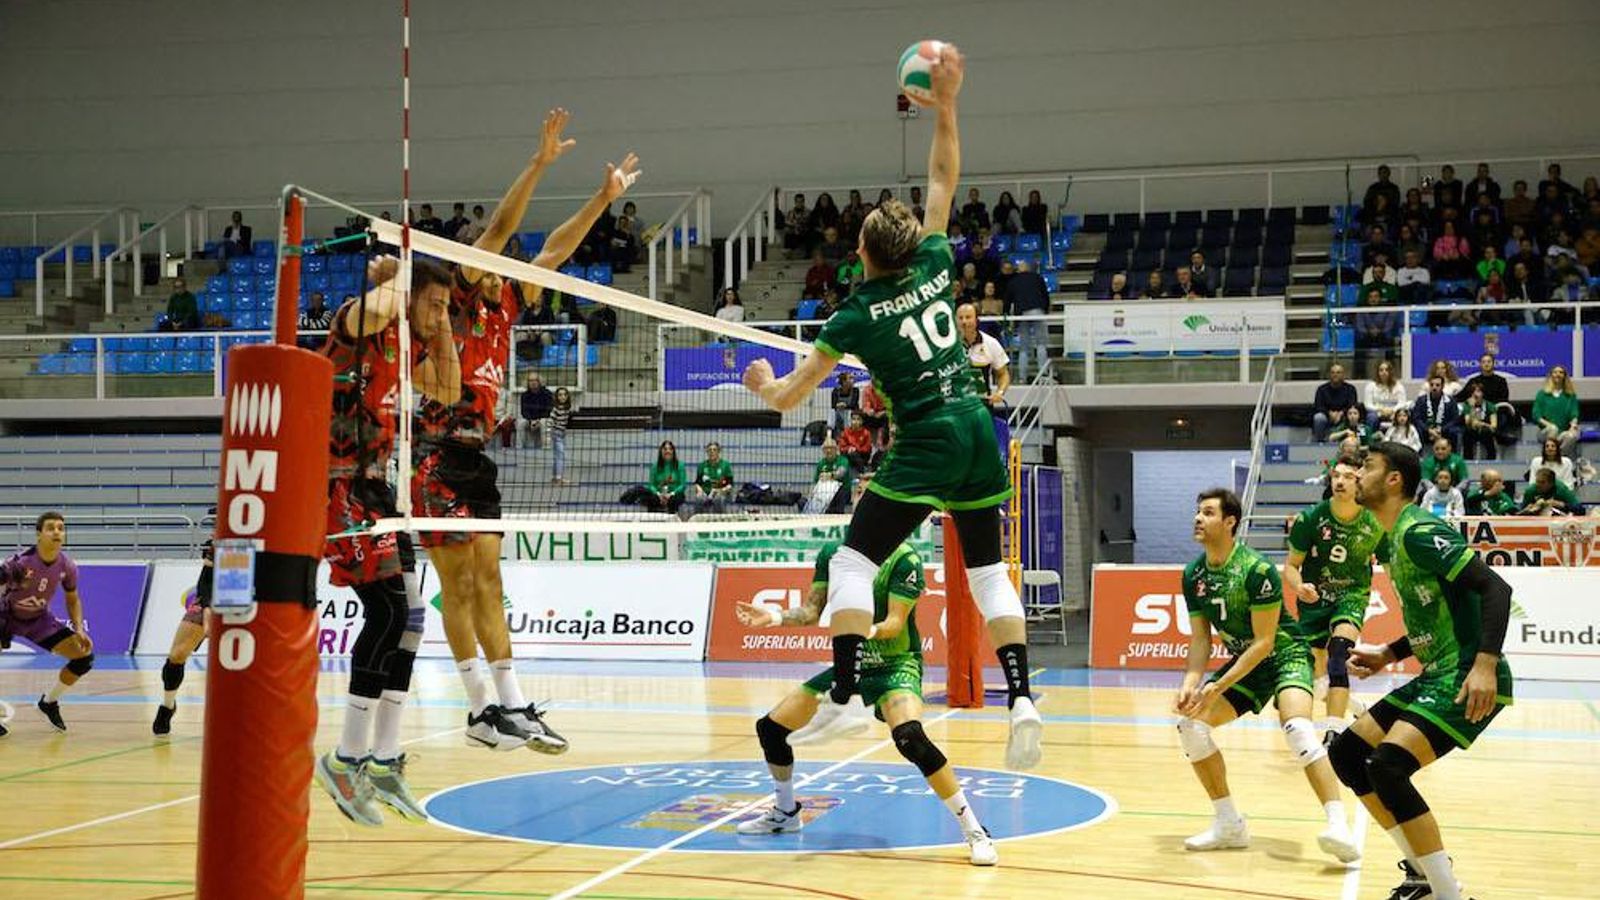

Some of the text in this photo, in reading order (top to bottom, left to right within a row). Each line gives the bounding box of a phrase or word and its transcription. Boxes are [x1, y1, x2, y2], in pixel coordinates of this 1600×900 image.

[869, 269, 951, 321] FRAN RUIZ
[898, 300, 957, 362] 10
[1329, 544, 1347, 563] 9
[38, 578, 49, 592] 8
[1210, 597, 1227, 621] 7
[507, 609, 695, 640] Unicaja Banco
[741, 634, 803, 649] SUPERLIGA
[1127, 642, 1189, 659] SUPERLIG
